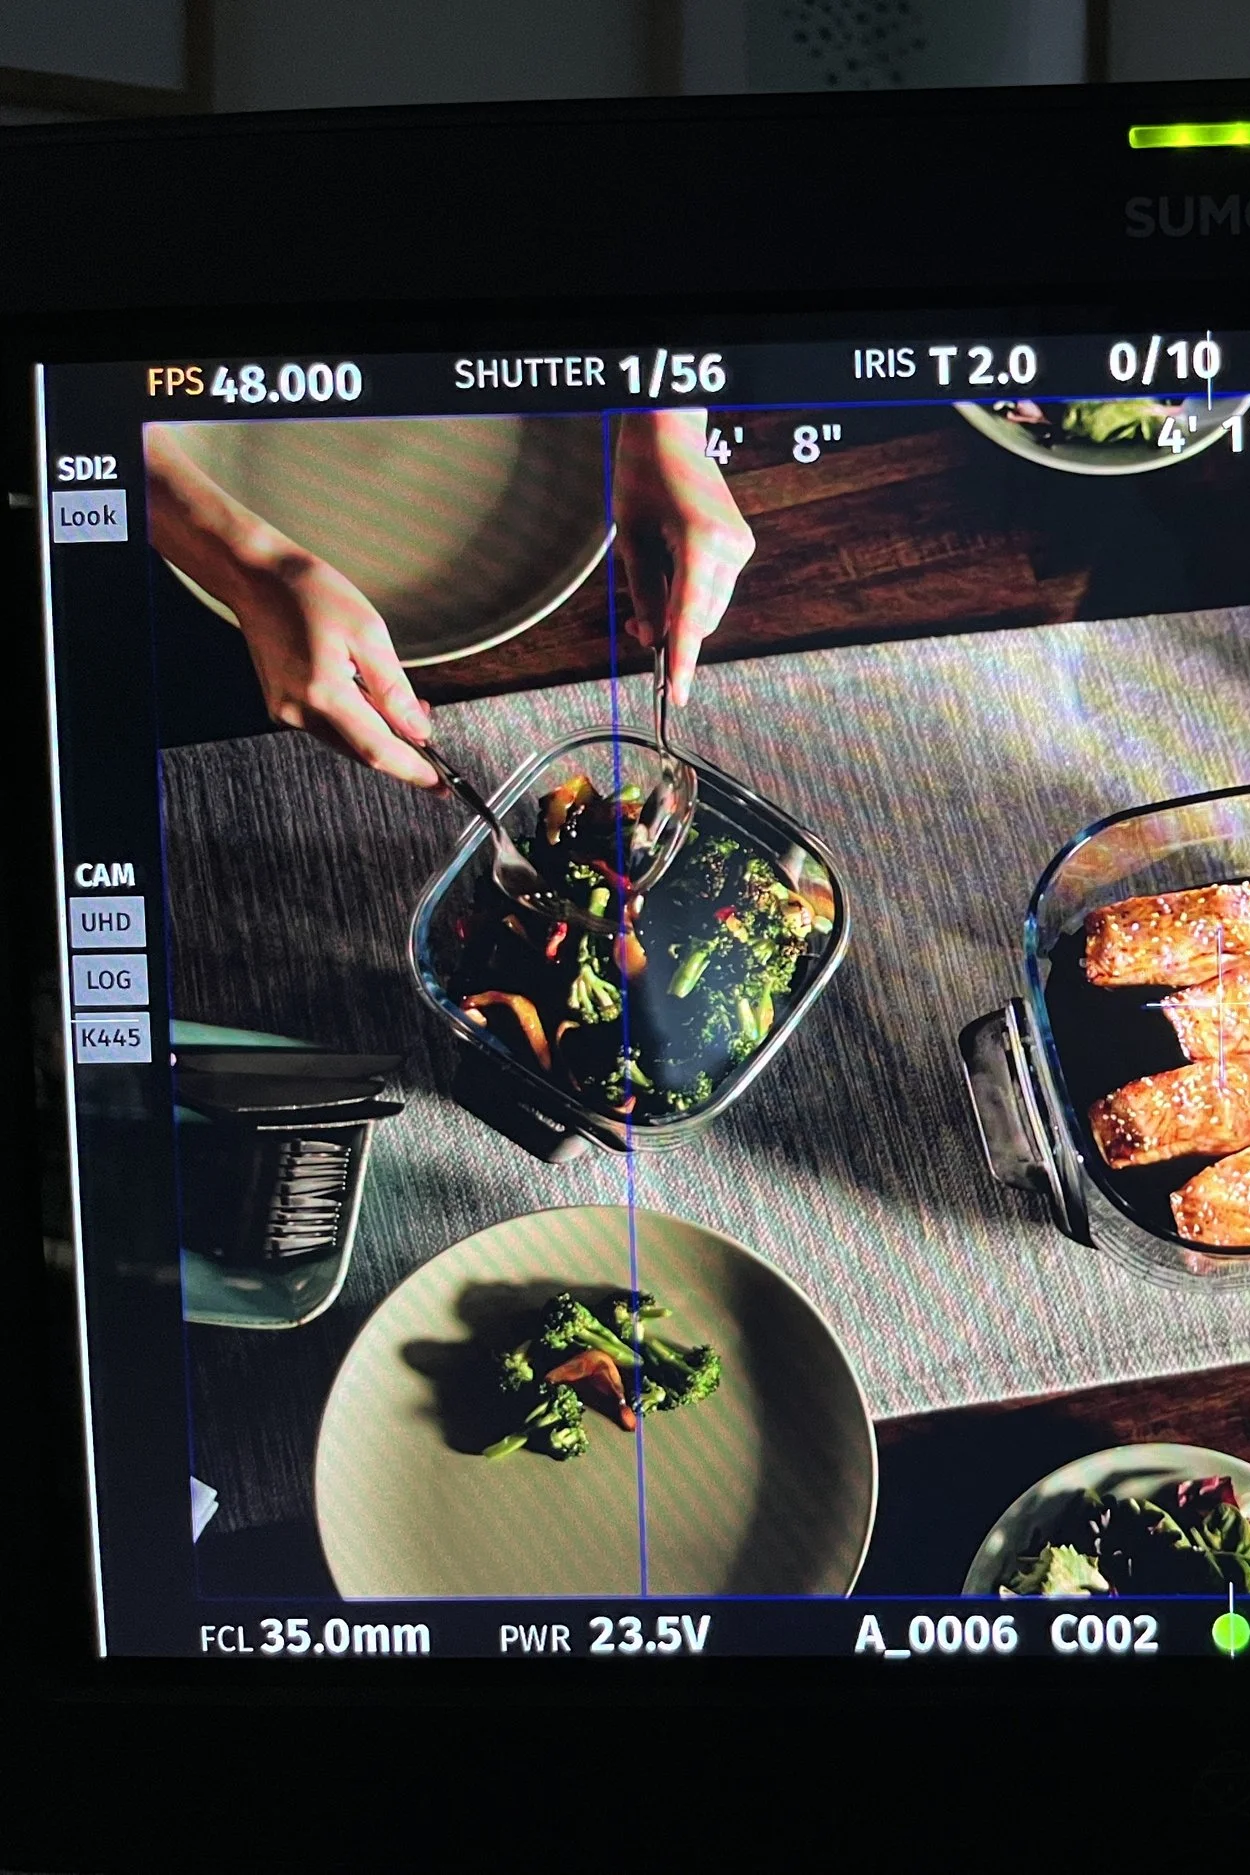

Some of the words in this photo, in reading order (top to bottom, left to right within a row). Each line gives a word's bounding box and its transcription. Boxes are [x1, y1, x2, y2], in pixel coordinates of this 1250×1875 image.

[455, 358, 606, 388] SHUTTER
[619, 349, 726, 399] 1/56
[854, 349, 916, 378] IRIS
[1109, 335, 1221, 384] 0/10
[147, 367, 204, 397] FPS
[211, 362, 363, 403] 48.000
[57, 455, 118, 482] SDI2
[59, 503, 117, 528] Look
[75, 862, 136, 888] CAM
[81, 912, 131, 932] UHD
[87, 970, 132, 990] LOG
[82, 1027, 141, 1048] K445
[200, 1624, 254, 1653] FCL
[260, 1617, 432, 1656] 35.0mm
[500, 1624, 571, 1653] PWR
[589, 1615, 711, 1653] 23.5V
[1050, 1614, 1159, 1653] C002
